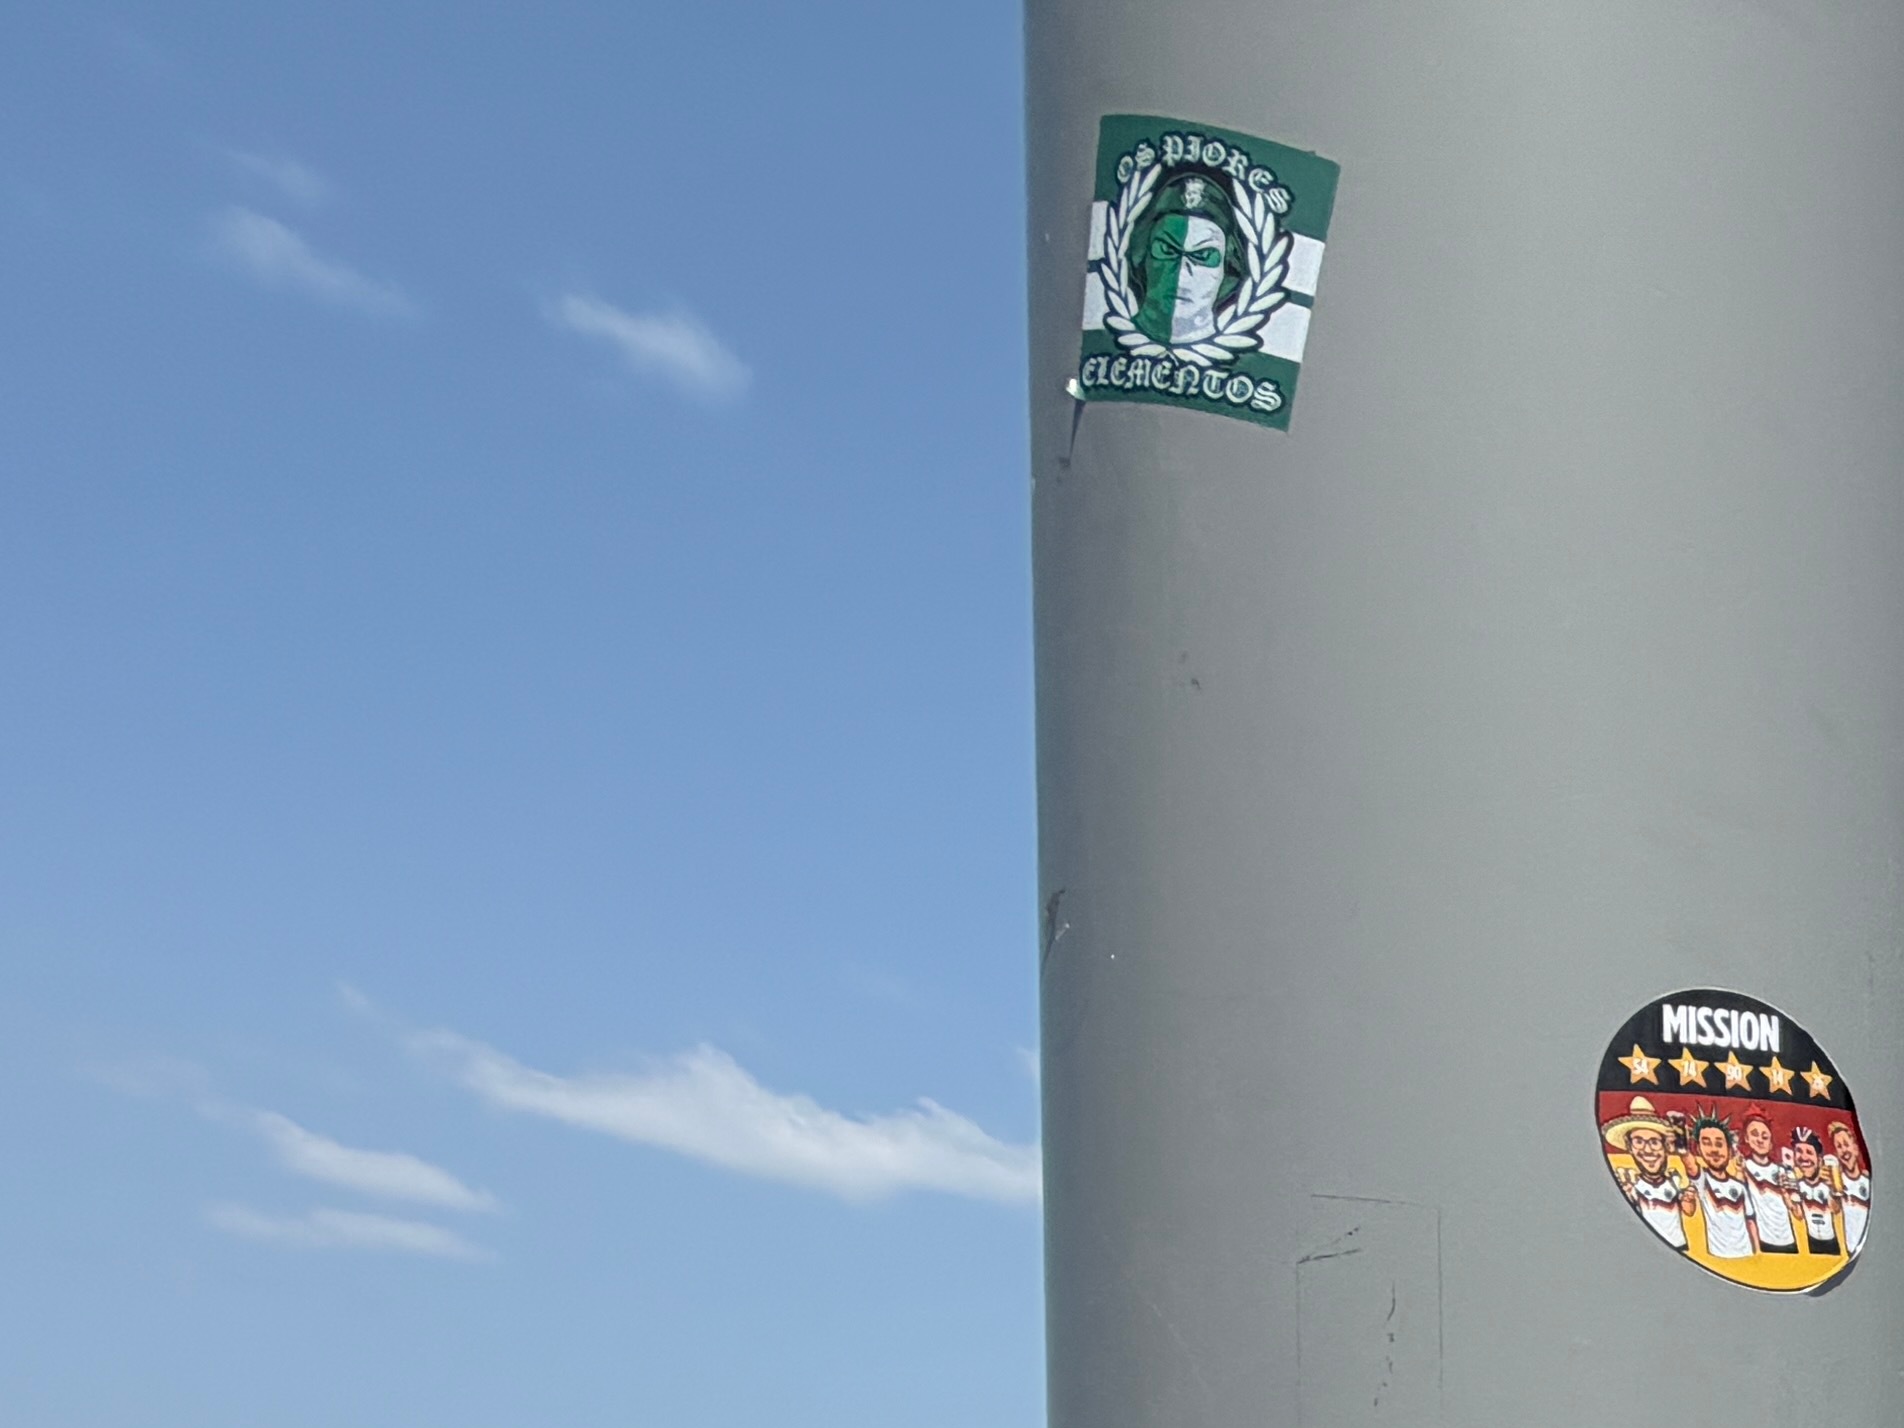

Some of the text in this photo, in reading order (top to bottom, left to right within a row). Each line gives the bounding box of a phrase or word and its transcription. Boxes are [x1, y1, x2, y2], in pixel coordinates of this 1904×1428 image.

[1116, 134, 1292, 214] OS PIORES
[1081, 355, 1283, 412] ELEMENTOS
[1662, 1004, 1780, 1053] MISSION
